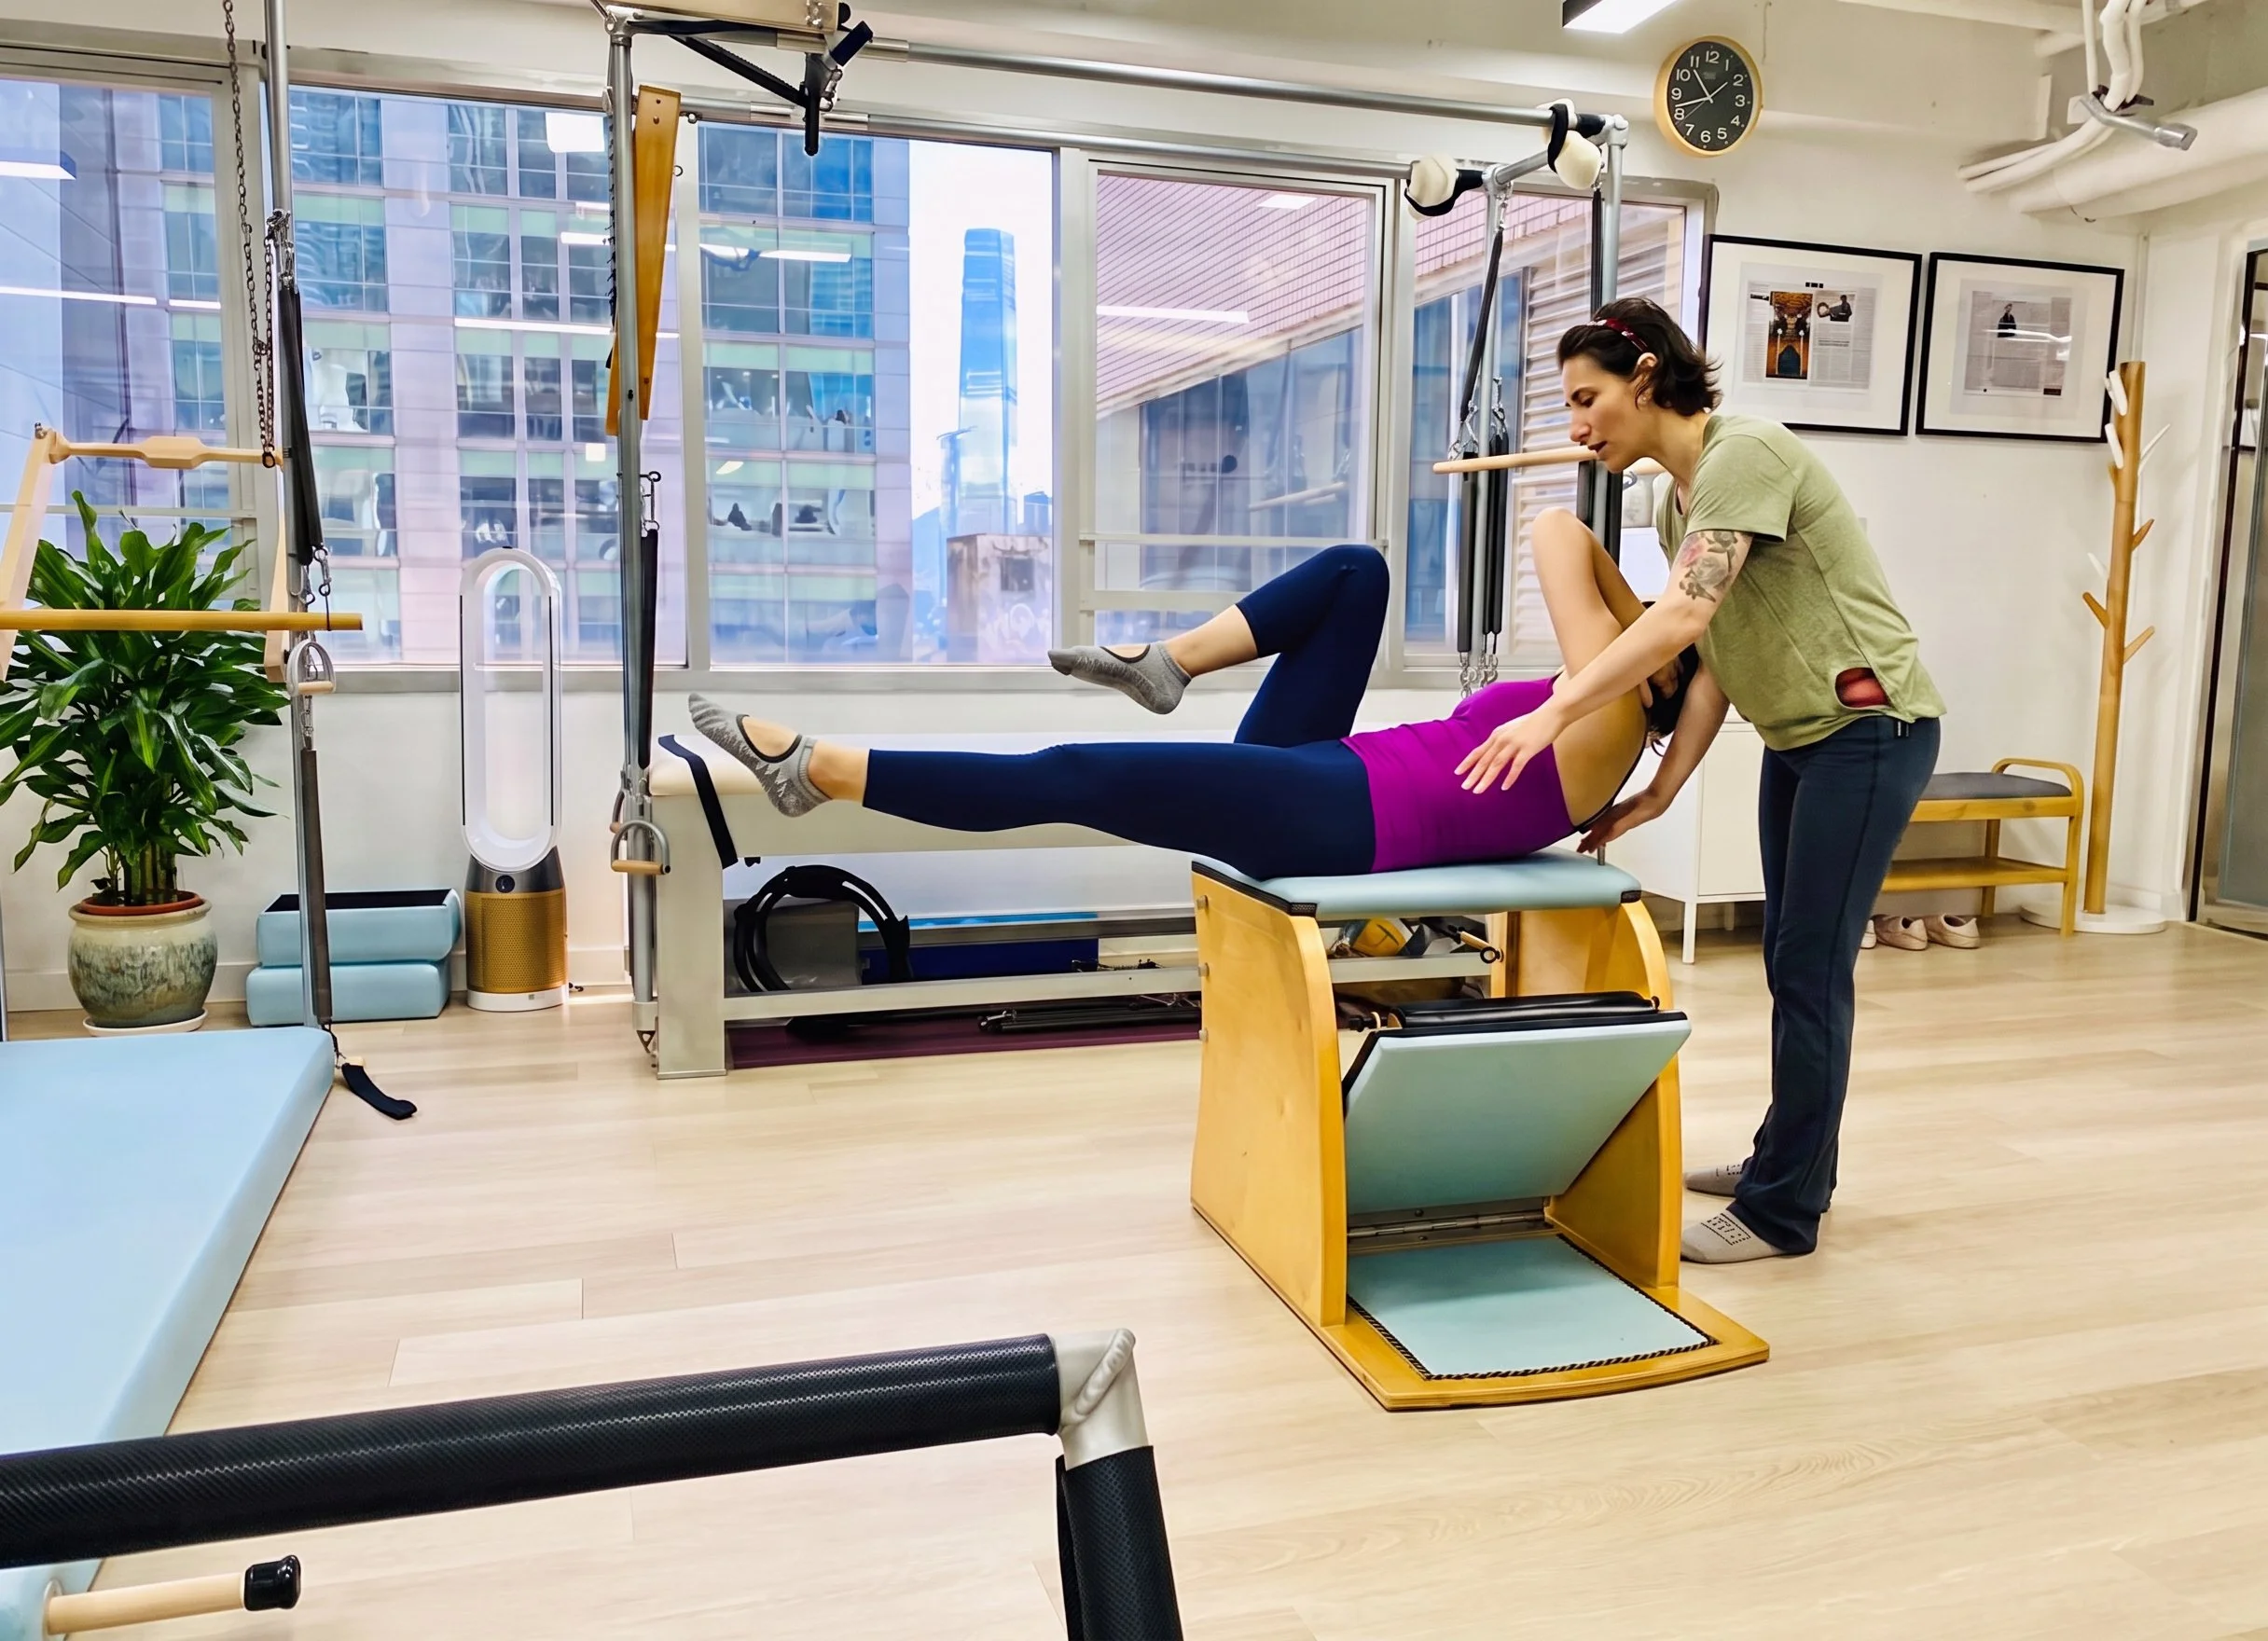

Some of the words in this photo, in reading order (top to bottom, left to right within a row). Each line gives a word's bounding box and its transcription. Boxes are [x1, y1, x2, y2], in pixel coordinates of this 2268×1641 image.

[1691, 55, 1699, 68] 11
[1706, 50, 1720, 63] 12
[1725, 59, 1729, 71] 1
[1676, 68, 1691, 81] 10
[1733, 75, 1743, 86] 2
[1671, 89, 1681, 100] 9
[1736, 95, 1745, 106] 3
[1674, 107, 1684, 120] 8
[1731, 115, 1740, 126] 4
[1685, 124, 1694, 136] 7
[1718, 128, 1727, 139] 5
[1701, 131, 1710, 143] 6
